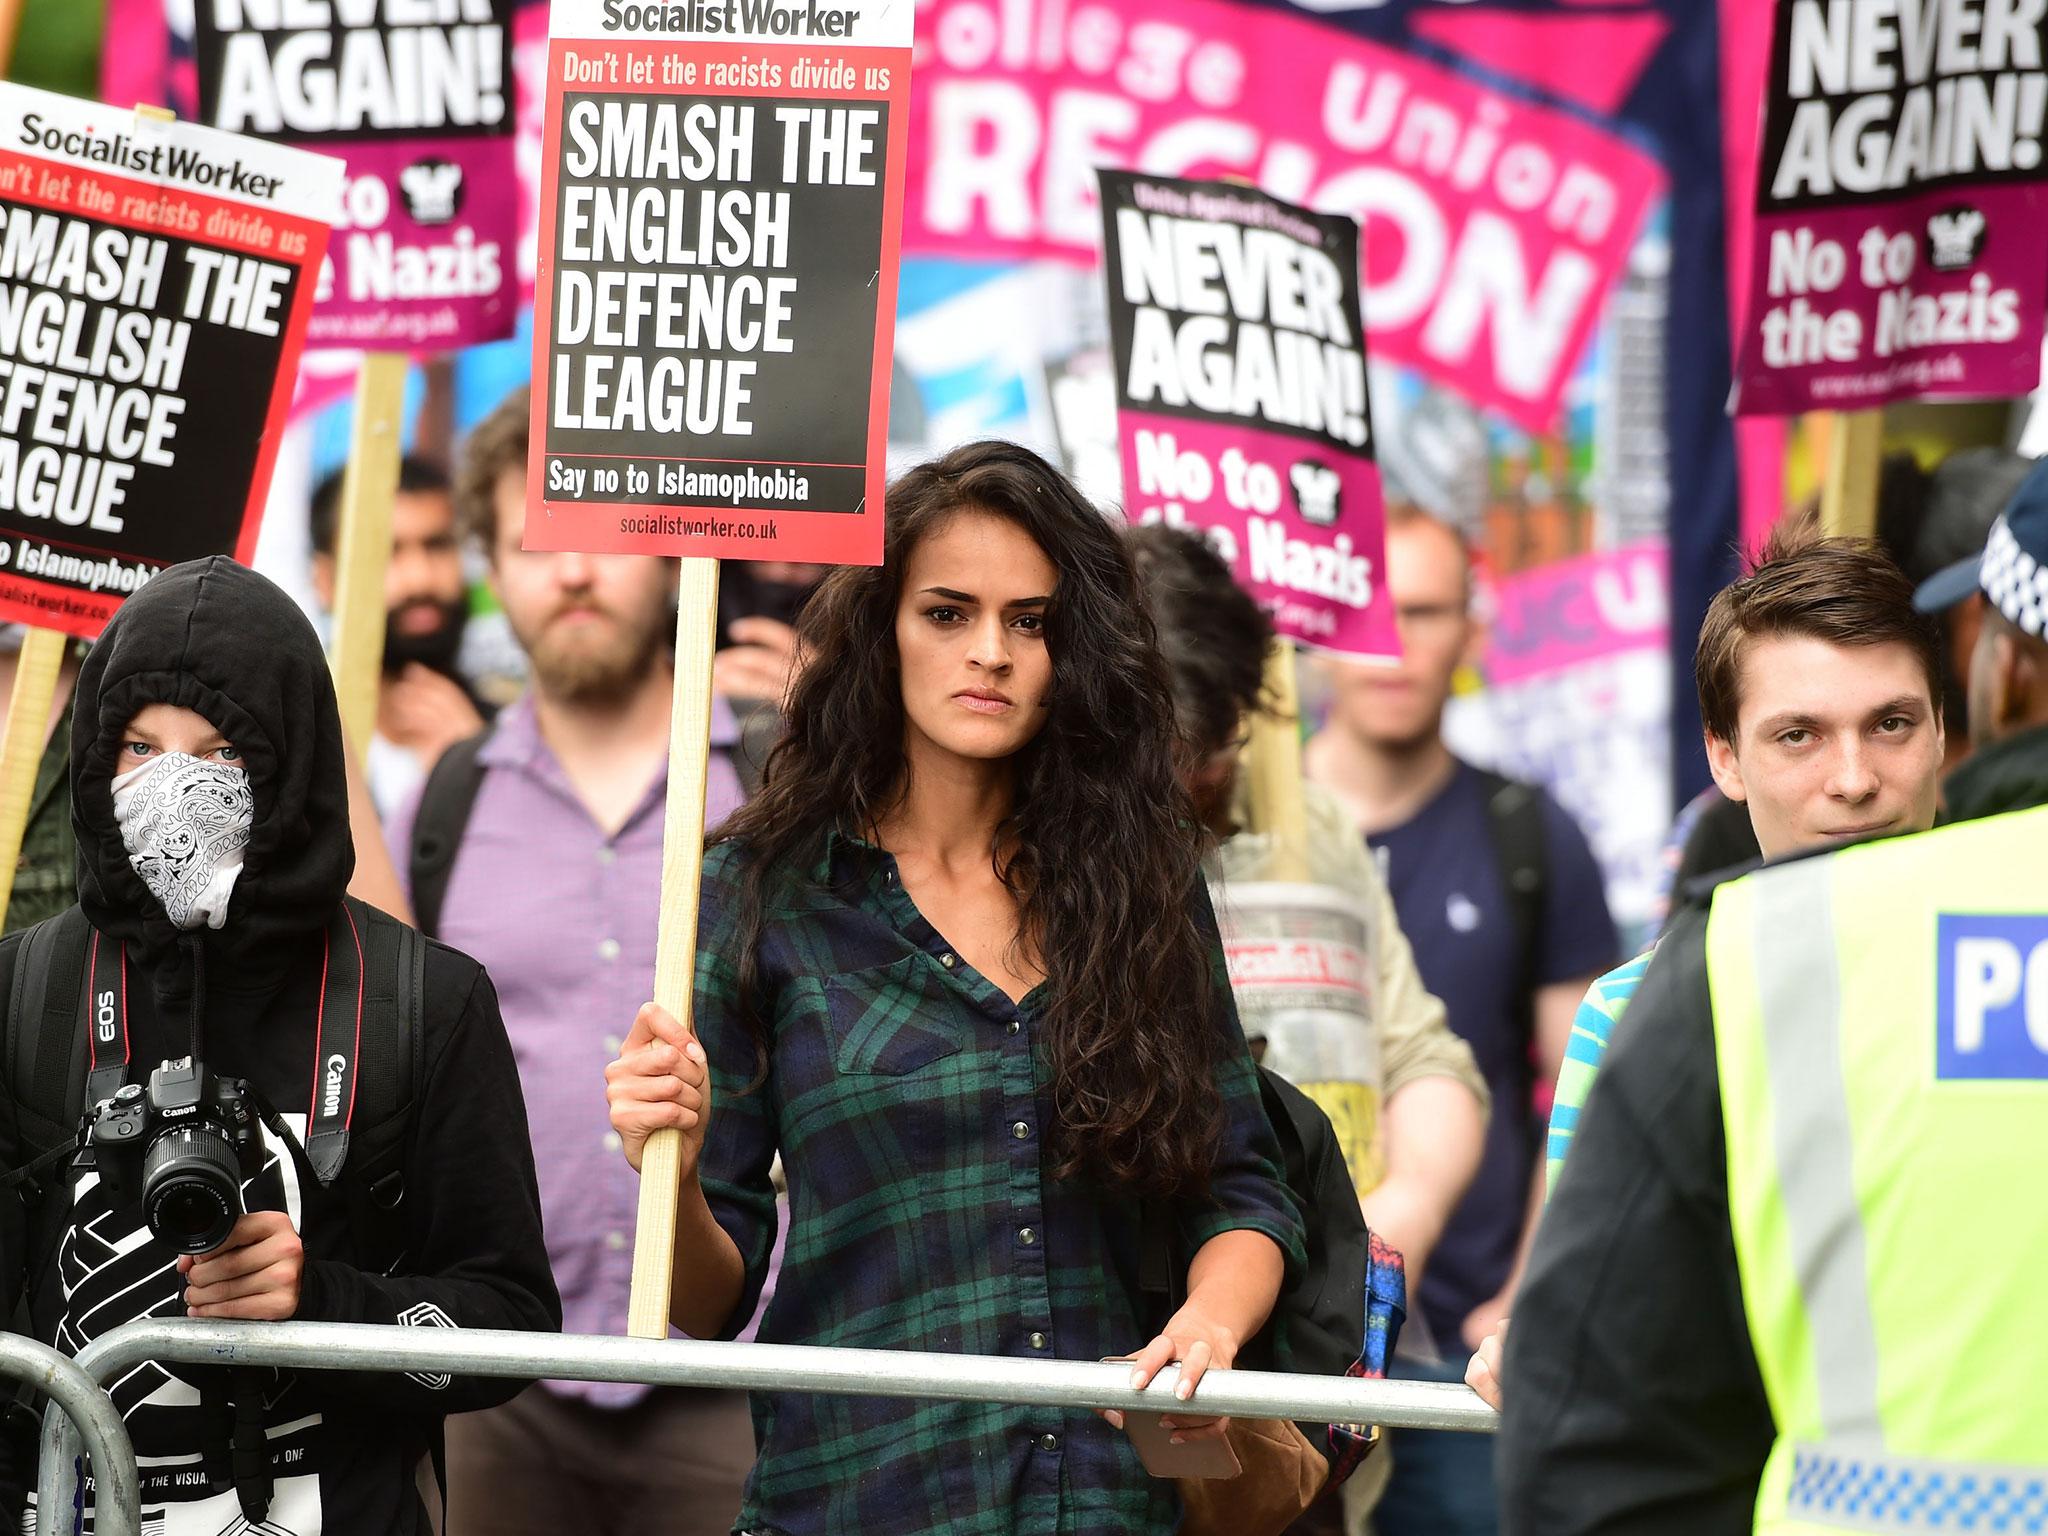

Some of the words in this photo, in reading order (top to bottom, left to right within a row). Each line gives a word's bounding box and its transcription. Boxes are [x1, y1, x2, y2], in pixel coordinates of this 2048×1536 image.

[214, 25, 505, 133] AGAIN!
[563, 51, 619, 84] Don't
[626, 53, 655, 84] let
[662, 54, 696, 86] the
[704, 56, 783, 89] racists
[790, 58, 856, 90] divide
[865, 67, 891, 92] us
[1788, 0, 2047, 98] NEVER
[565, 99, 755, 183] SMASH
[775, 107, 880, 187] THE
[914, 0, 1244, 107] ollege
[1321, 61, 1618, 245] Union
[1771, 71, 2047, 199] AGAIN!
[38, 168, 72, 203] let
[76, 178, 116, 214] the
[121, 193, 201, 233] racists
[206, 206, 273, 248] divide
[279, 229, 308, 256] us
[562, 185, 791, 269] ENGLISH
[183, 246, 291, 337] THE
[348, 226, 503, 302] Nazis
[1116, 208, 1352, 348] NEVER
[1767, 227, 1847, 297] No
[1858, 226, 1917, 288] to
[0, 281, 191, 391] NGLISH
[556, 270, 799, 353] DEFENCE
[1760, 299, 1862, 369] the
[1874, 271, 2020, 358] Nazis
[0, 358, 186, 467] FENCE
[553, 354, 757, 436] LEAGUE
[1127, 306, 1368, 447] AGAIN!
[0, 436, 136, 533] AGUE
[549, 459, 586, 498] Say
[593, 469, 618, 493] no
[626, 464, 649, 494] to
[657, 464, 809, 504] Islamophobia
[1134, 429, 1213, 503] No
[1219, 447, 1281, 515] to
[16, 539, 160, 592] Islamophob
[620, 514, 777, 539] socialistworker.co.uk
[1248, 516, 1373, 609] Nazis
[98, 990, 115, 1042] EOS
[162, 1105, 197, 1118] Canon
[324, 1054, 346, 1117] Canon
[151, 1474, 169, 1488] THE
[175, 1471, 210, 1486] VISUA
[285, 1448, 305, 1463] ONE
